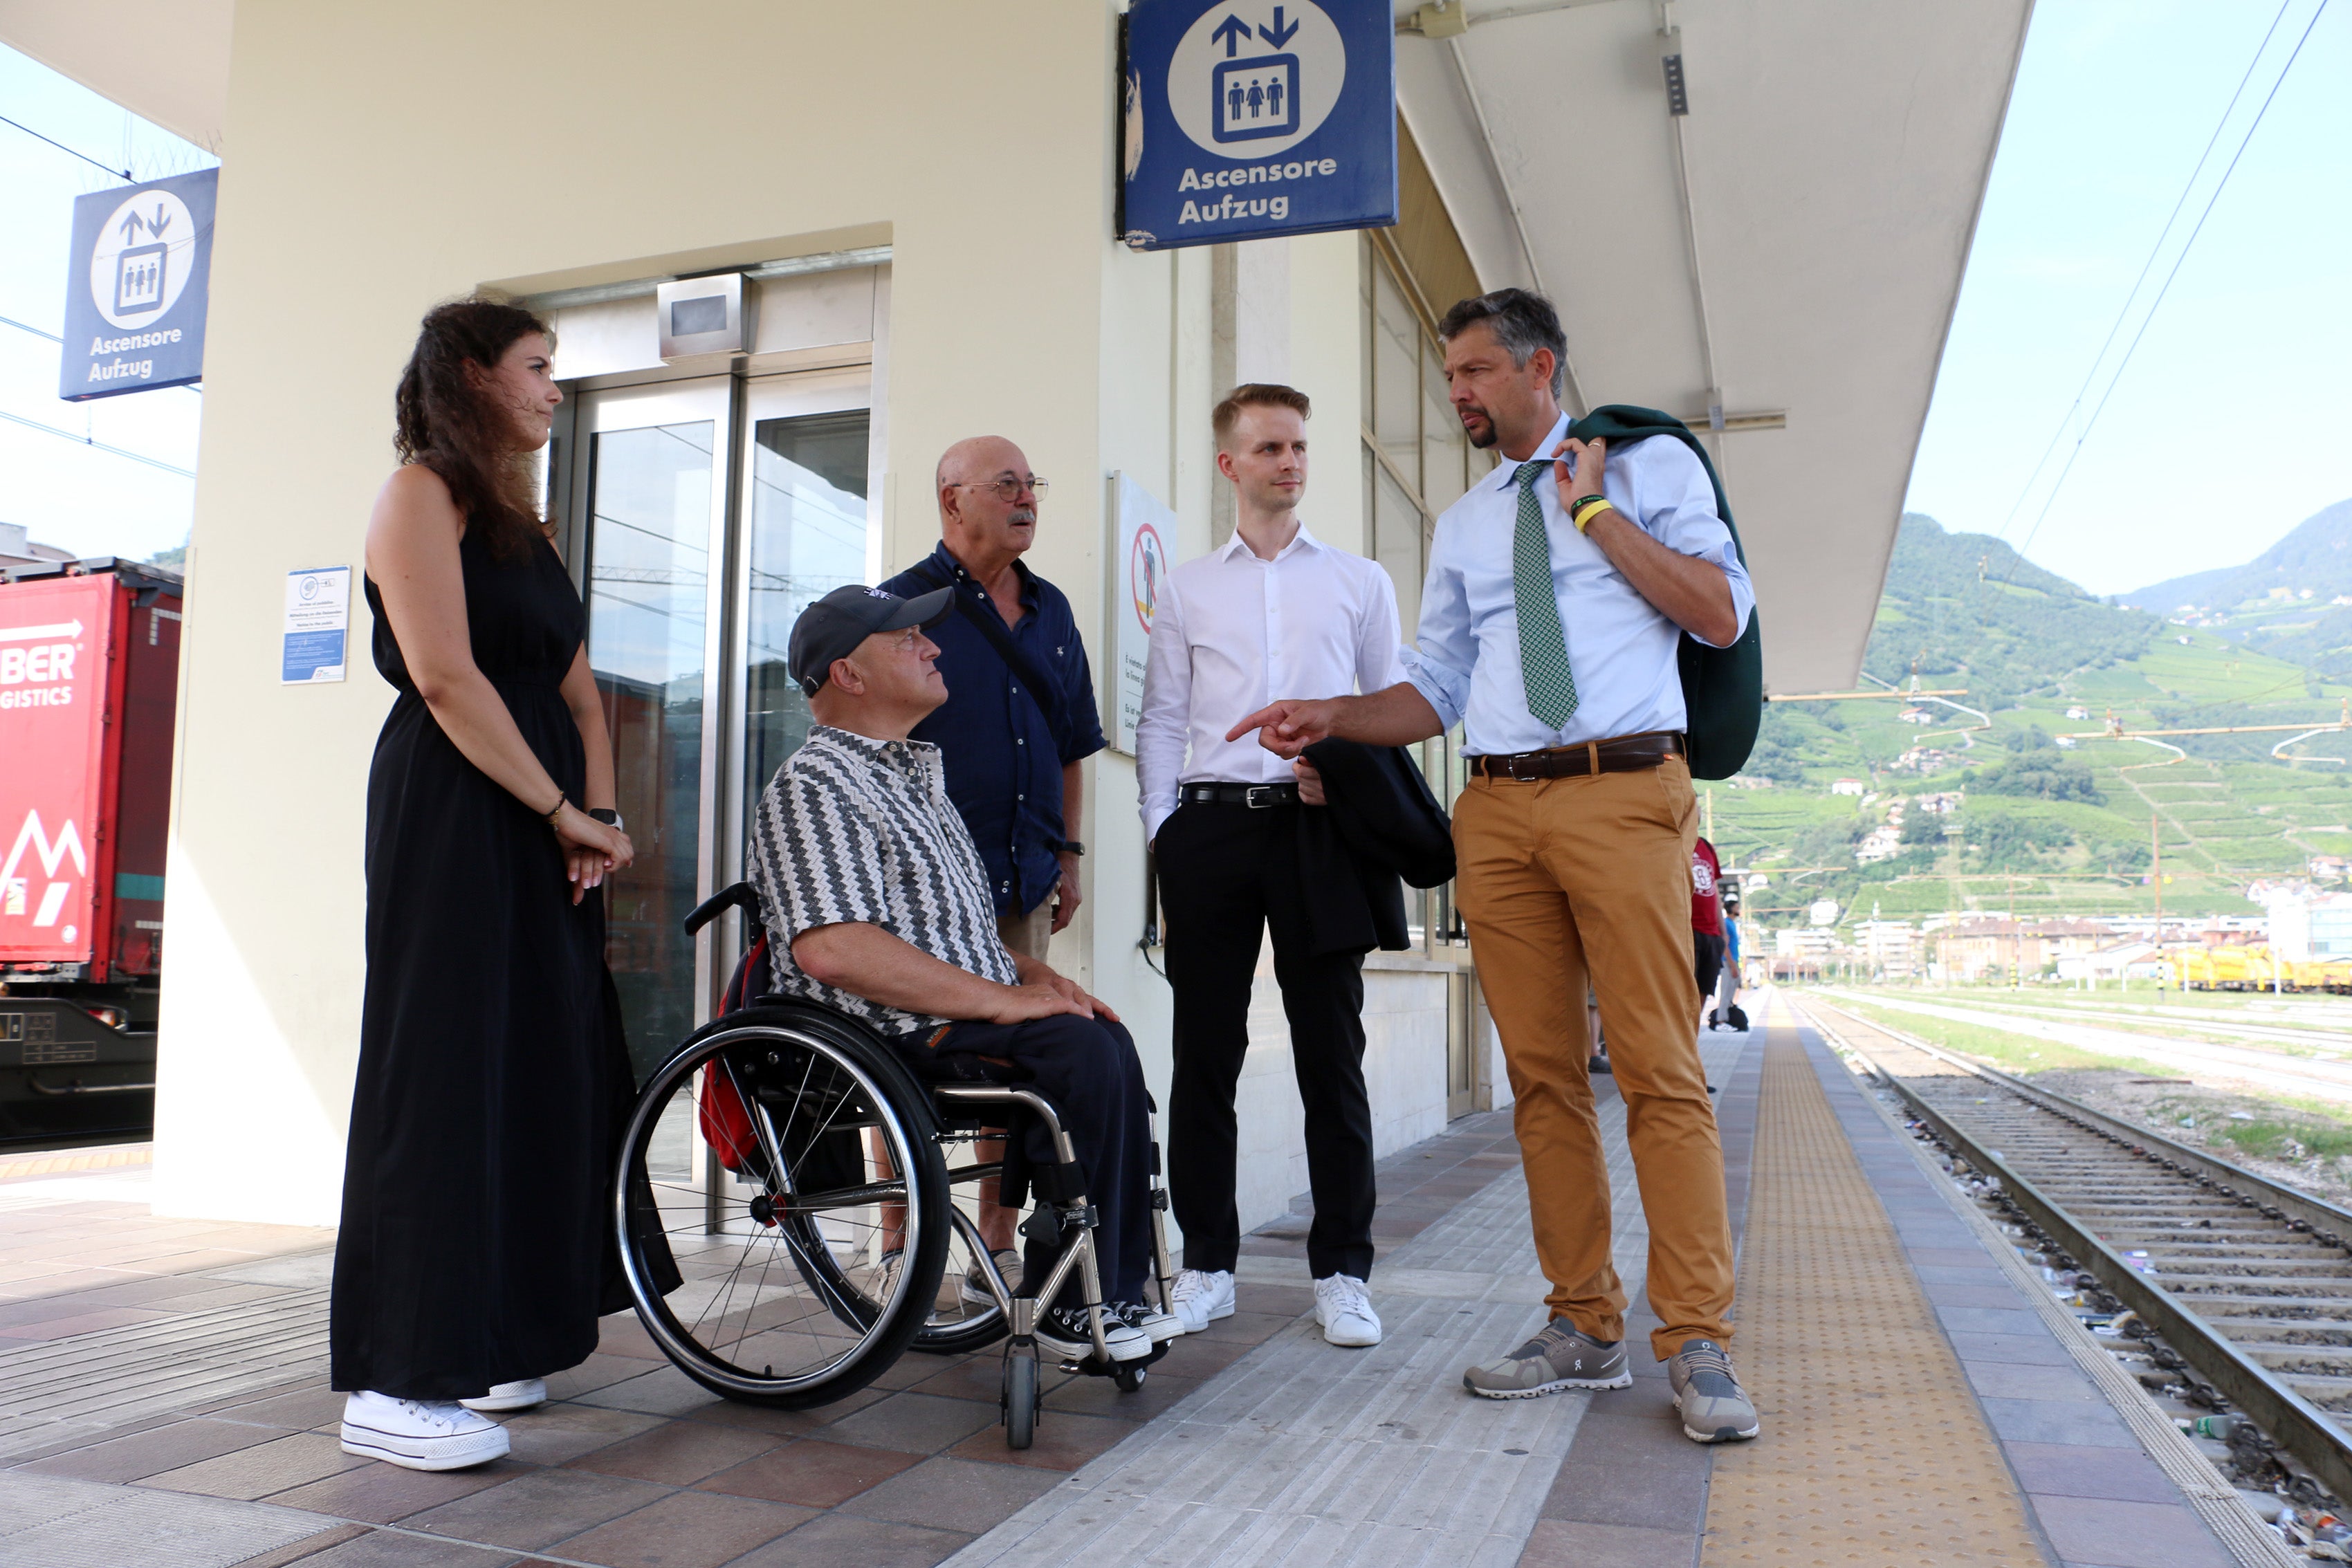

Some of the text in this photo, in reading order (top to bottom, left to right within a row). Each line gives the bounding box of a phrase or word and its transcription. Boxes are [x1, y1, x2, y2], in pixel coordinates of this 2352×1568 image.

[1177, 158, 1337, 192] Ascensore
[1177, 194, 1289, 225] Aufzug
[89, 329, 182, 356] Ascensore
[87, 358, 153, 382] Aufzug
[1129, 656, 1143, 670] vietato
[1130, 670, 1140, 683] linea
